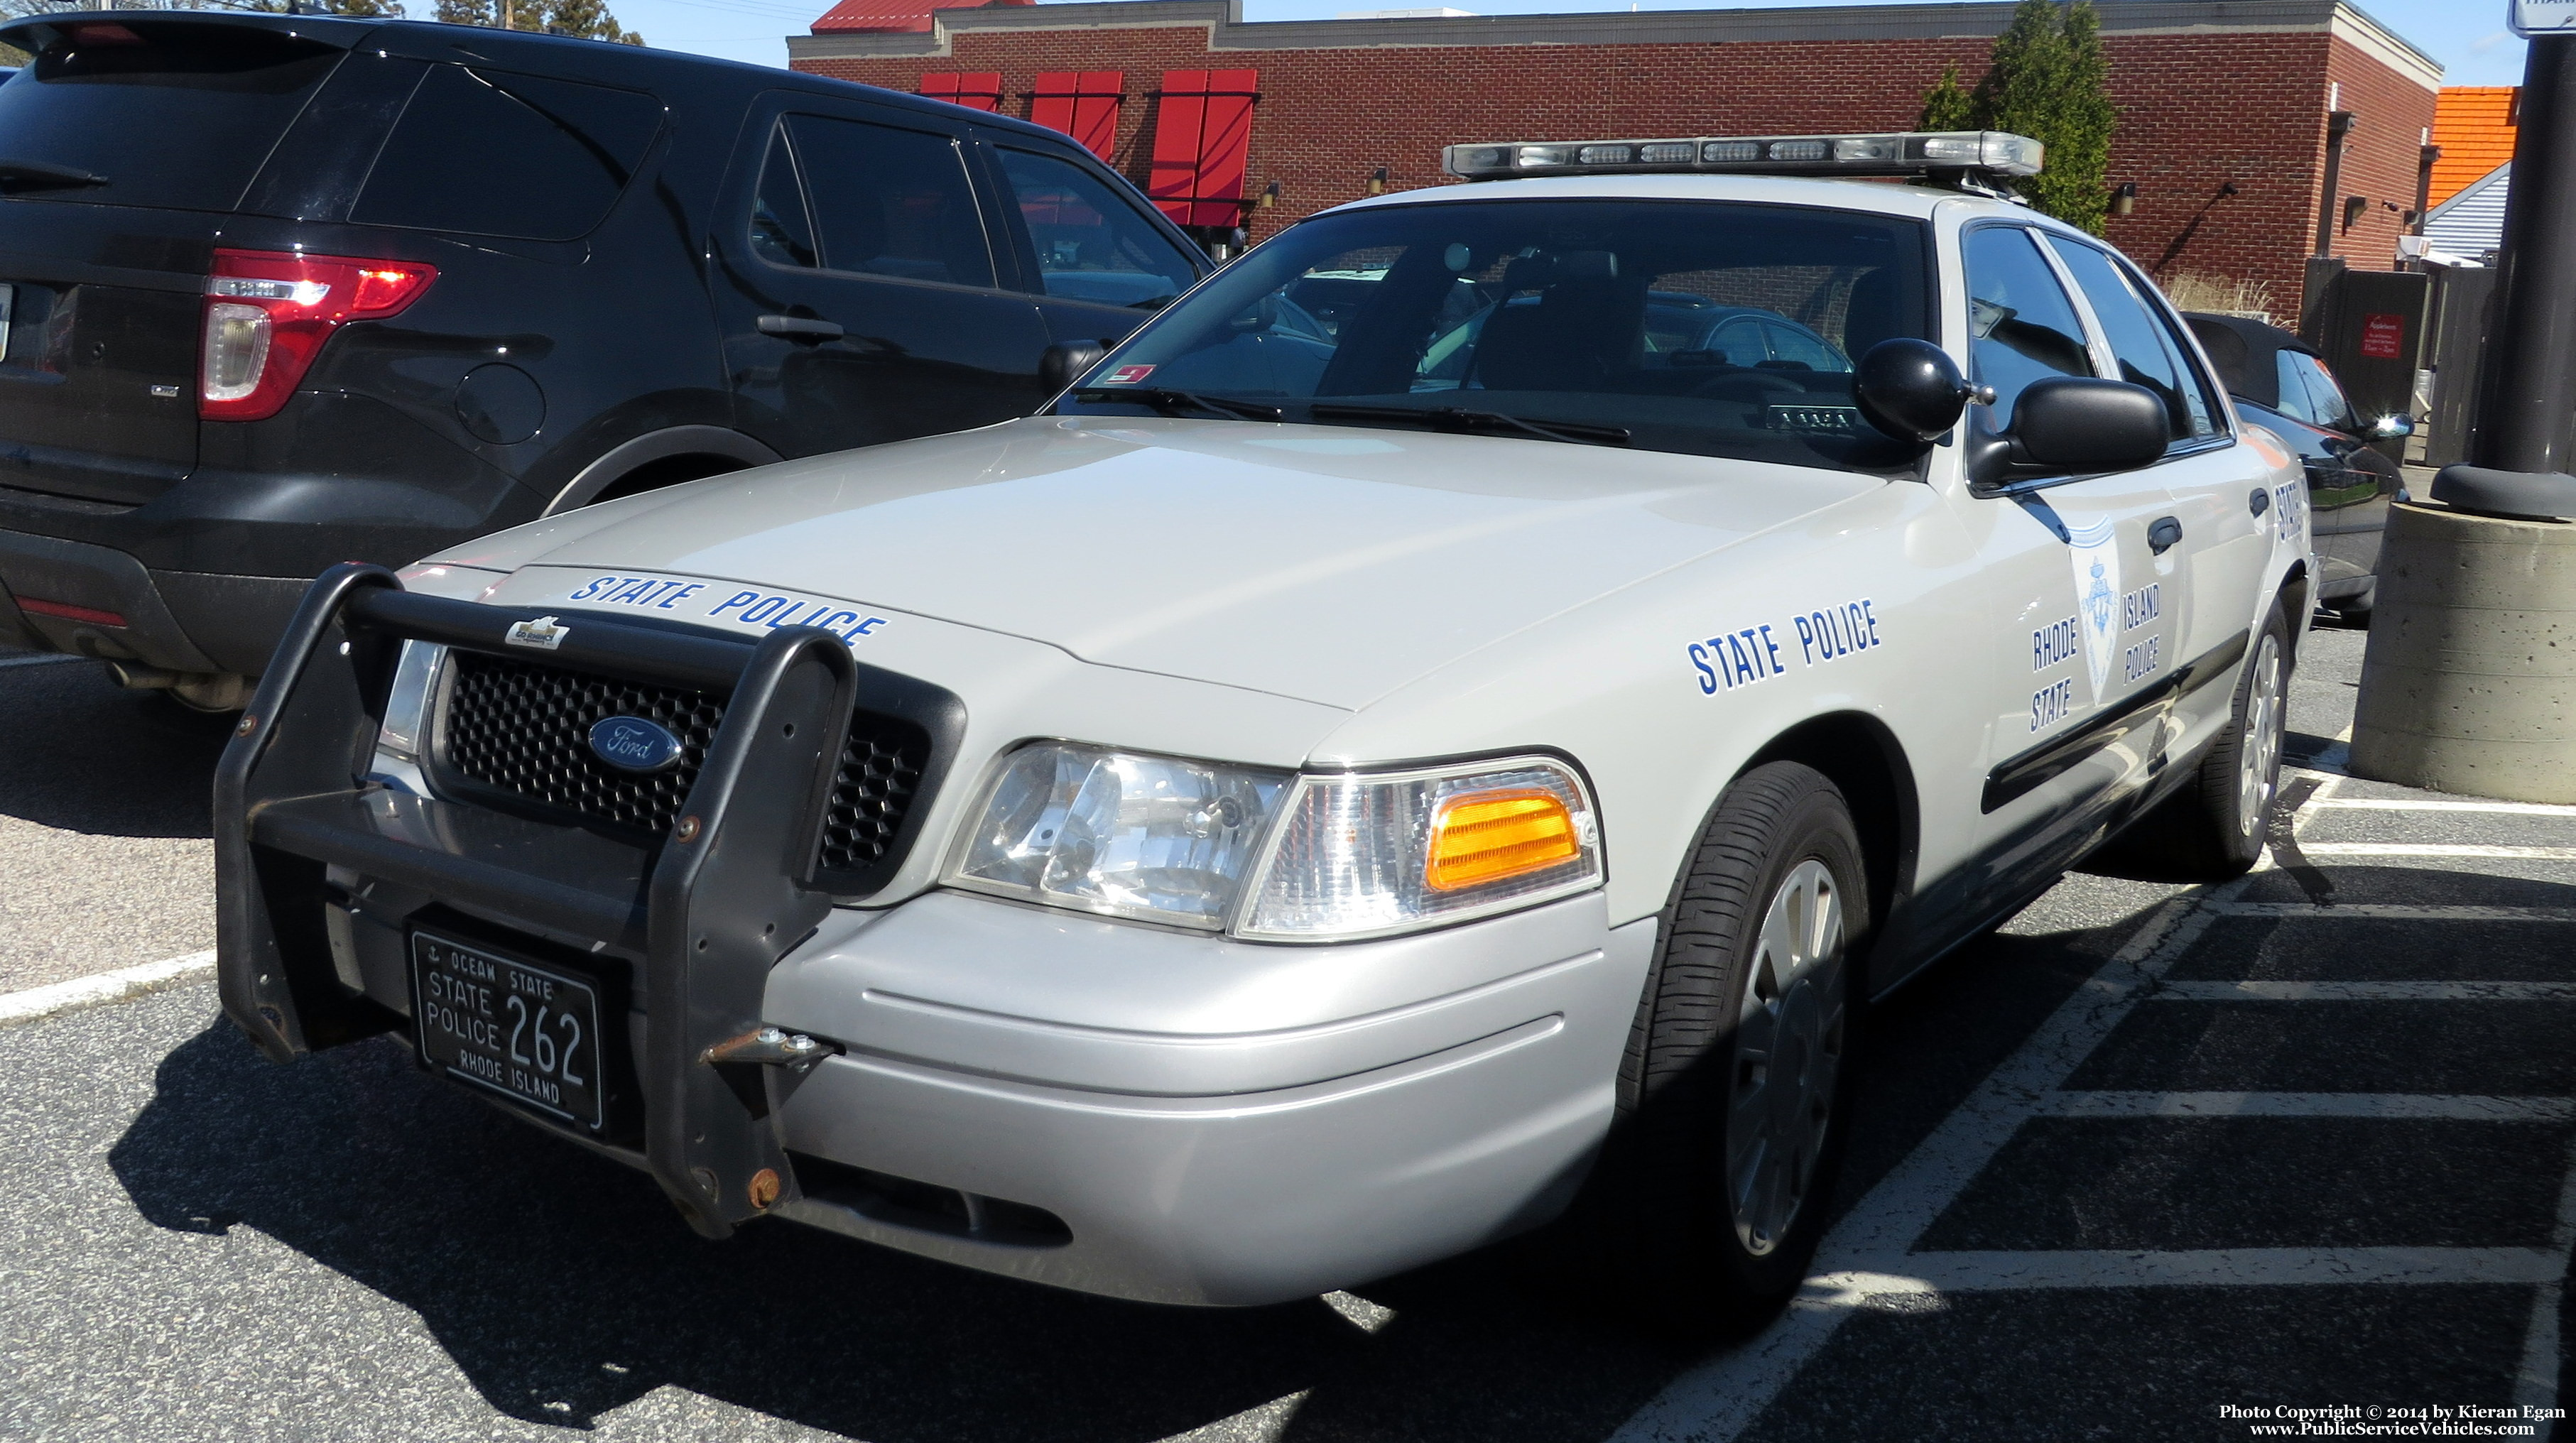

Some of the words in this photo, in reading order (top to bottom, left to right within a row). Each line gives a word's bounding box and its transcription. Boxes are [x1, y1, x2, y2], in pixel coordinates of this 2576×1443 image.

[567, 575, 710, 611] STATE
[704, 589, 891, 648] POLICE
[1687, 622, 1786, 697] STATE
[1791, 597, 1881, 668] POLICE
[2032, 615, 2077, 673] RHODE
[2122, 582, 2159, 633] ISLAND
[2030, 676, 2072, 734] STATE
[2123, 634, 2159, 686] POLICE
[607, 725, 655, 759] Ford
[451, 952, 496, 983] OCEAN
[510, 971, 553, 1000] STATE
[428, 1001, 501, 1051] POLICE
[430, 971, 492, 1015] STATE
[507, 995, 583, 1086] 262
[460, 1048, 503, 1082] RHODE
[511, 1067, 560, 1104] ISLAND
